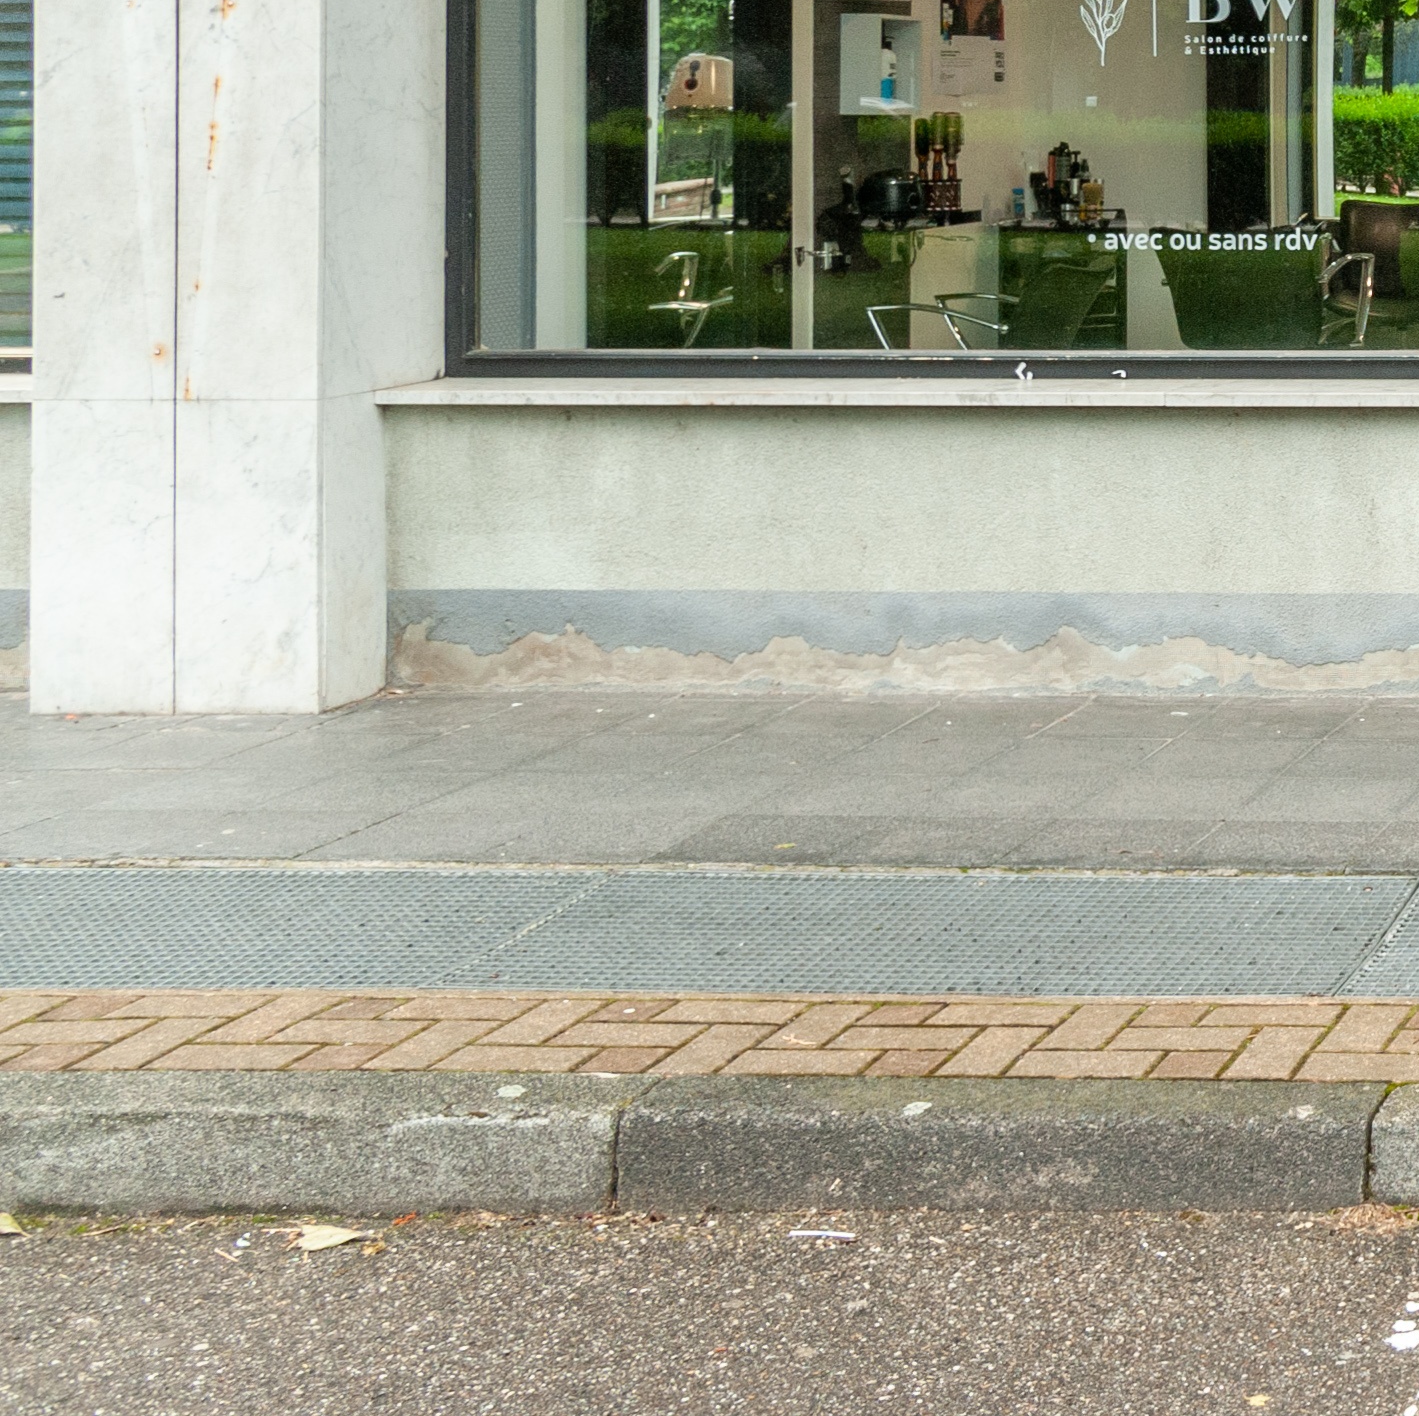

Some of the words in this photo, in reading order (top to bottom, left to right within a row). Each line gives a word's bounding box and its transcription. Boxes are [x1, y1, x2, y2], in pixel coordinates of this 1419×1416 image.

[1184, 34, 1222, 44] Salon
[1229, 33, 1245, 43] de
[1250, 33, 1309, 43] coiffure
[1184, 46, 1192, 55] &
[1200, 45, 1276, 56] Esthétique
[1104, 233, 1163, 251] avec
[1169, 233, 1202, 251] ou
[1208, 233, 1268, 251] sans
[1273, 227, 1319, 251] rdv
